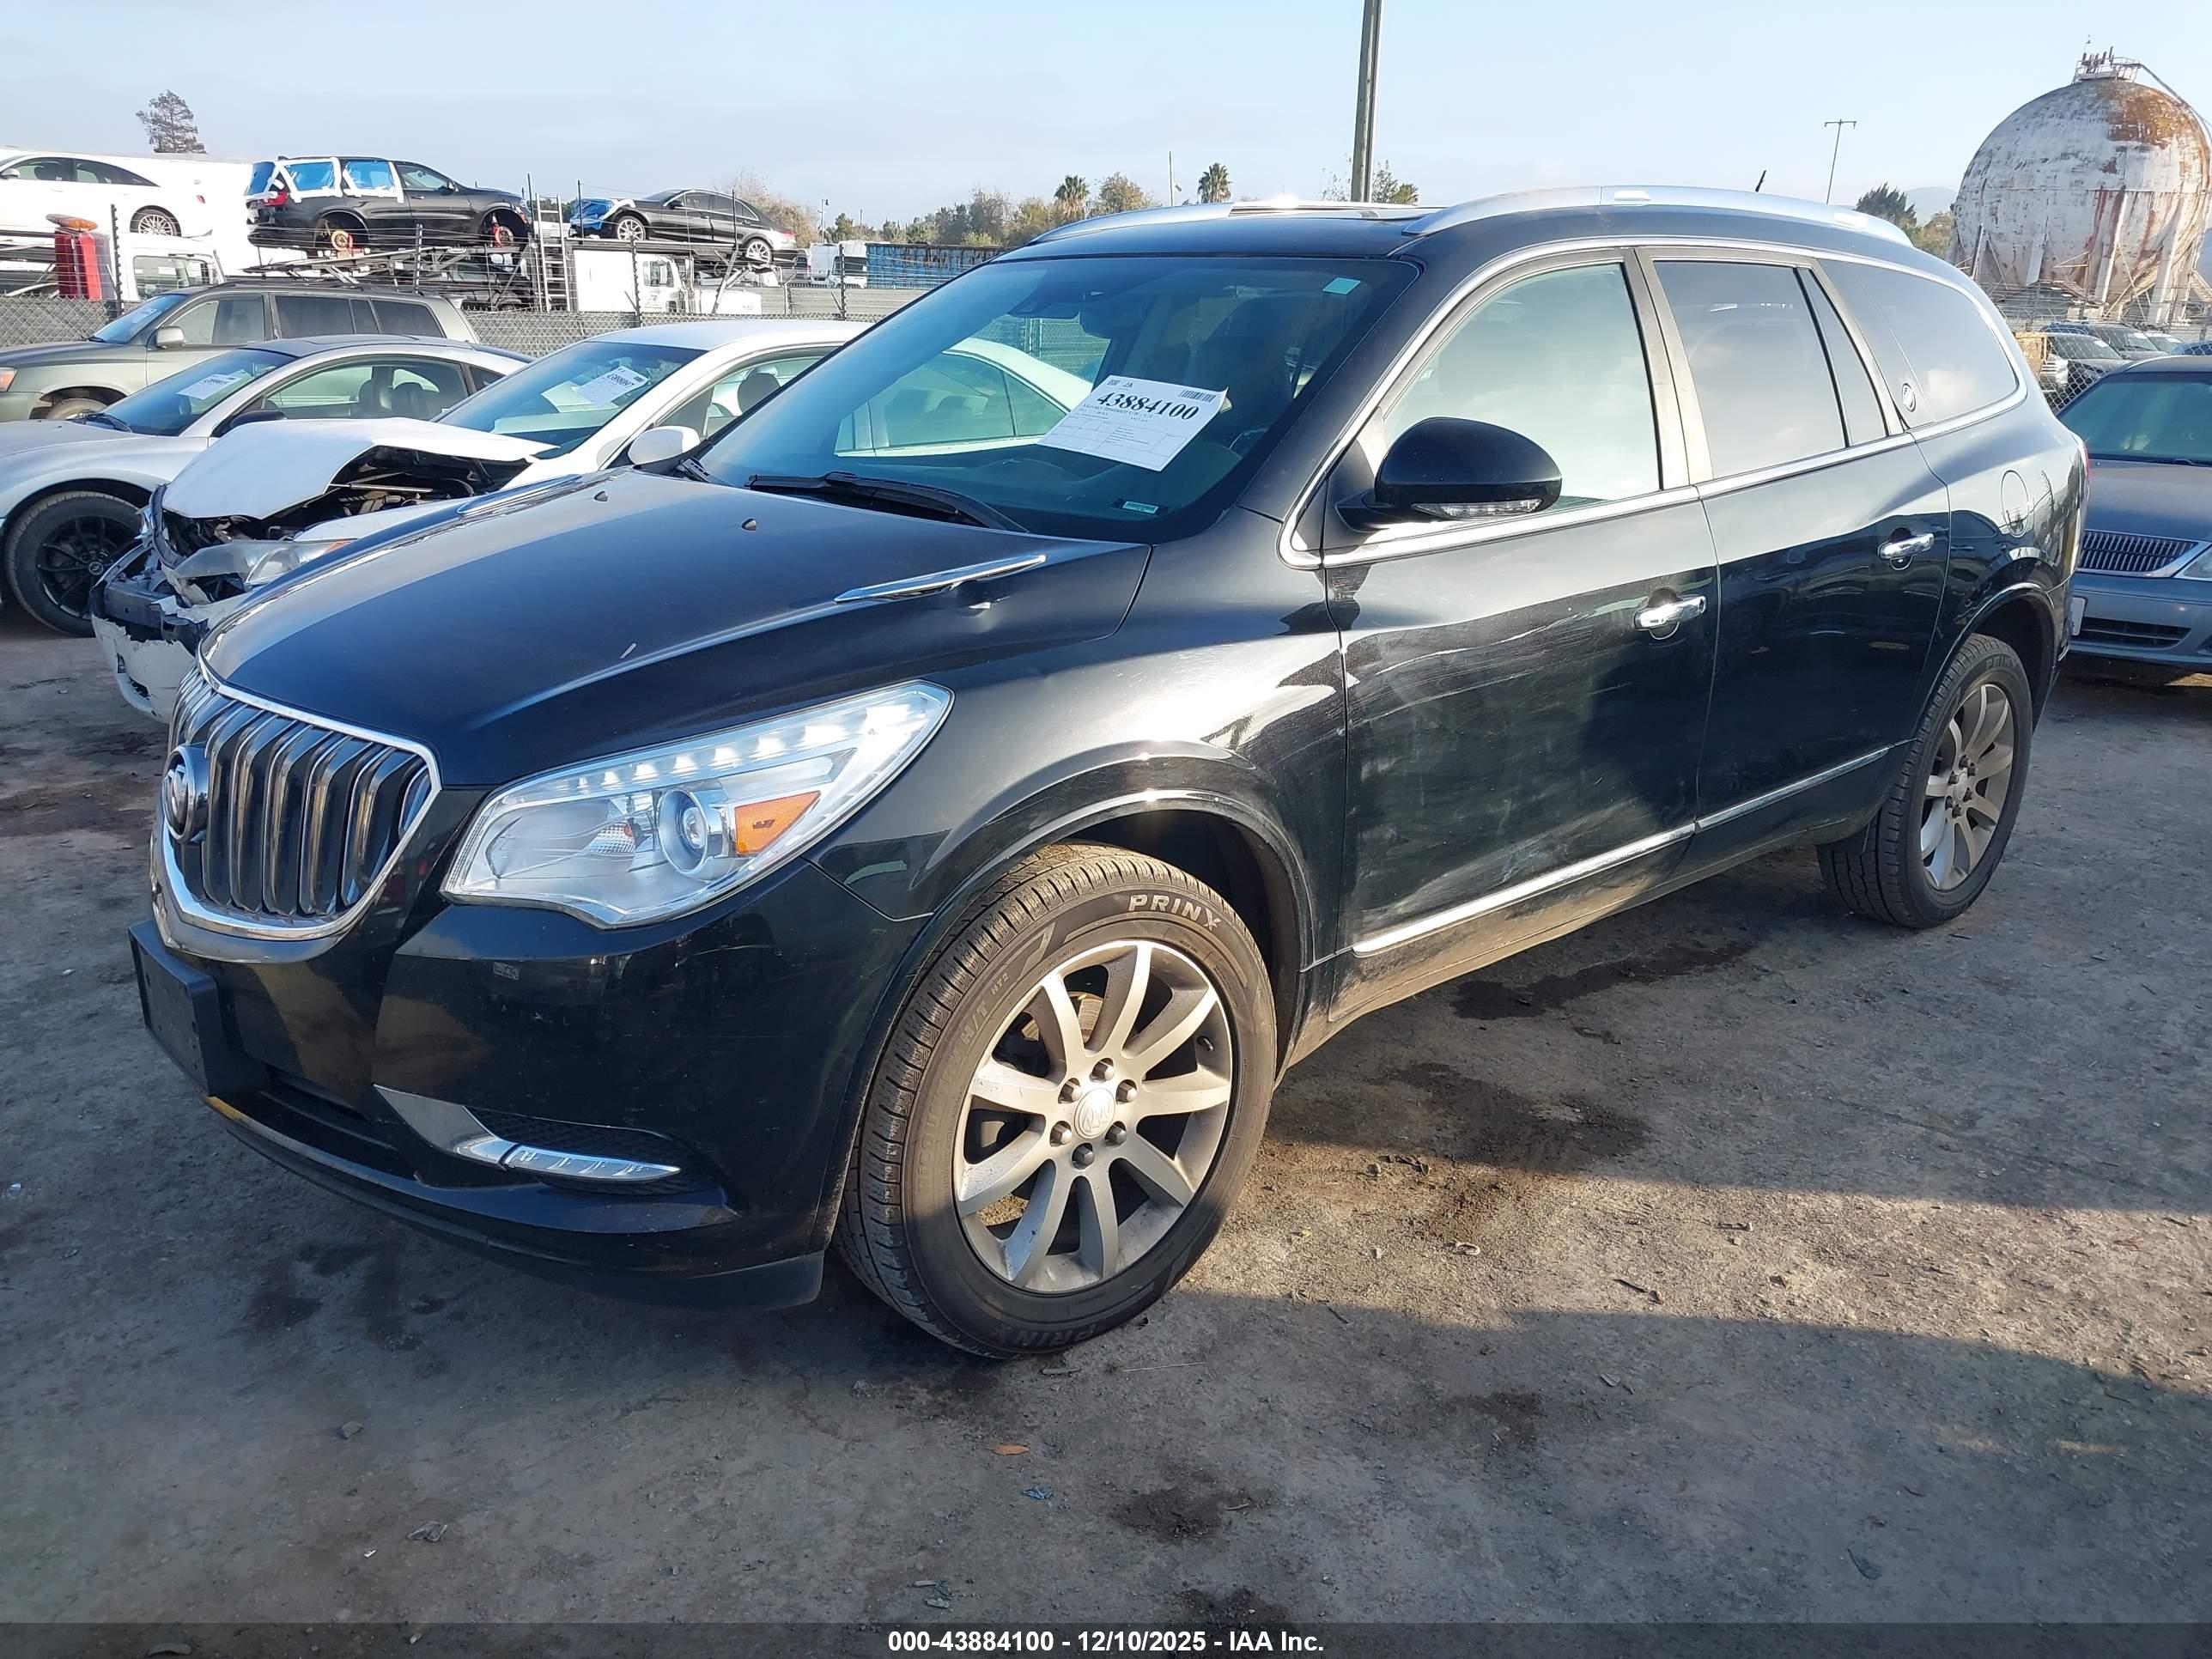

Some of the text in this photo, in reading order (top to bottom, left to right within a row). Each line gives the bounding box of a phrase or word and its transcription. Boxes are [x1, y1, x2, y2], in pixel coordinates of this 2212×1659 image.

[1097, 392, 1200, 421] 43884100
[1127, 894, 1222, 932] PRINX
[990, 973, 1010, 996] HT2
